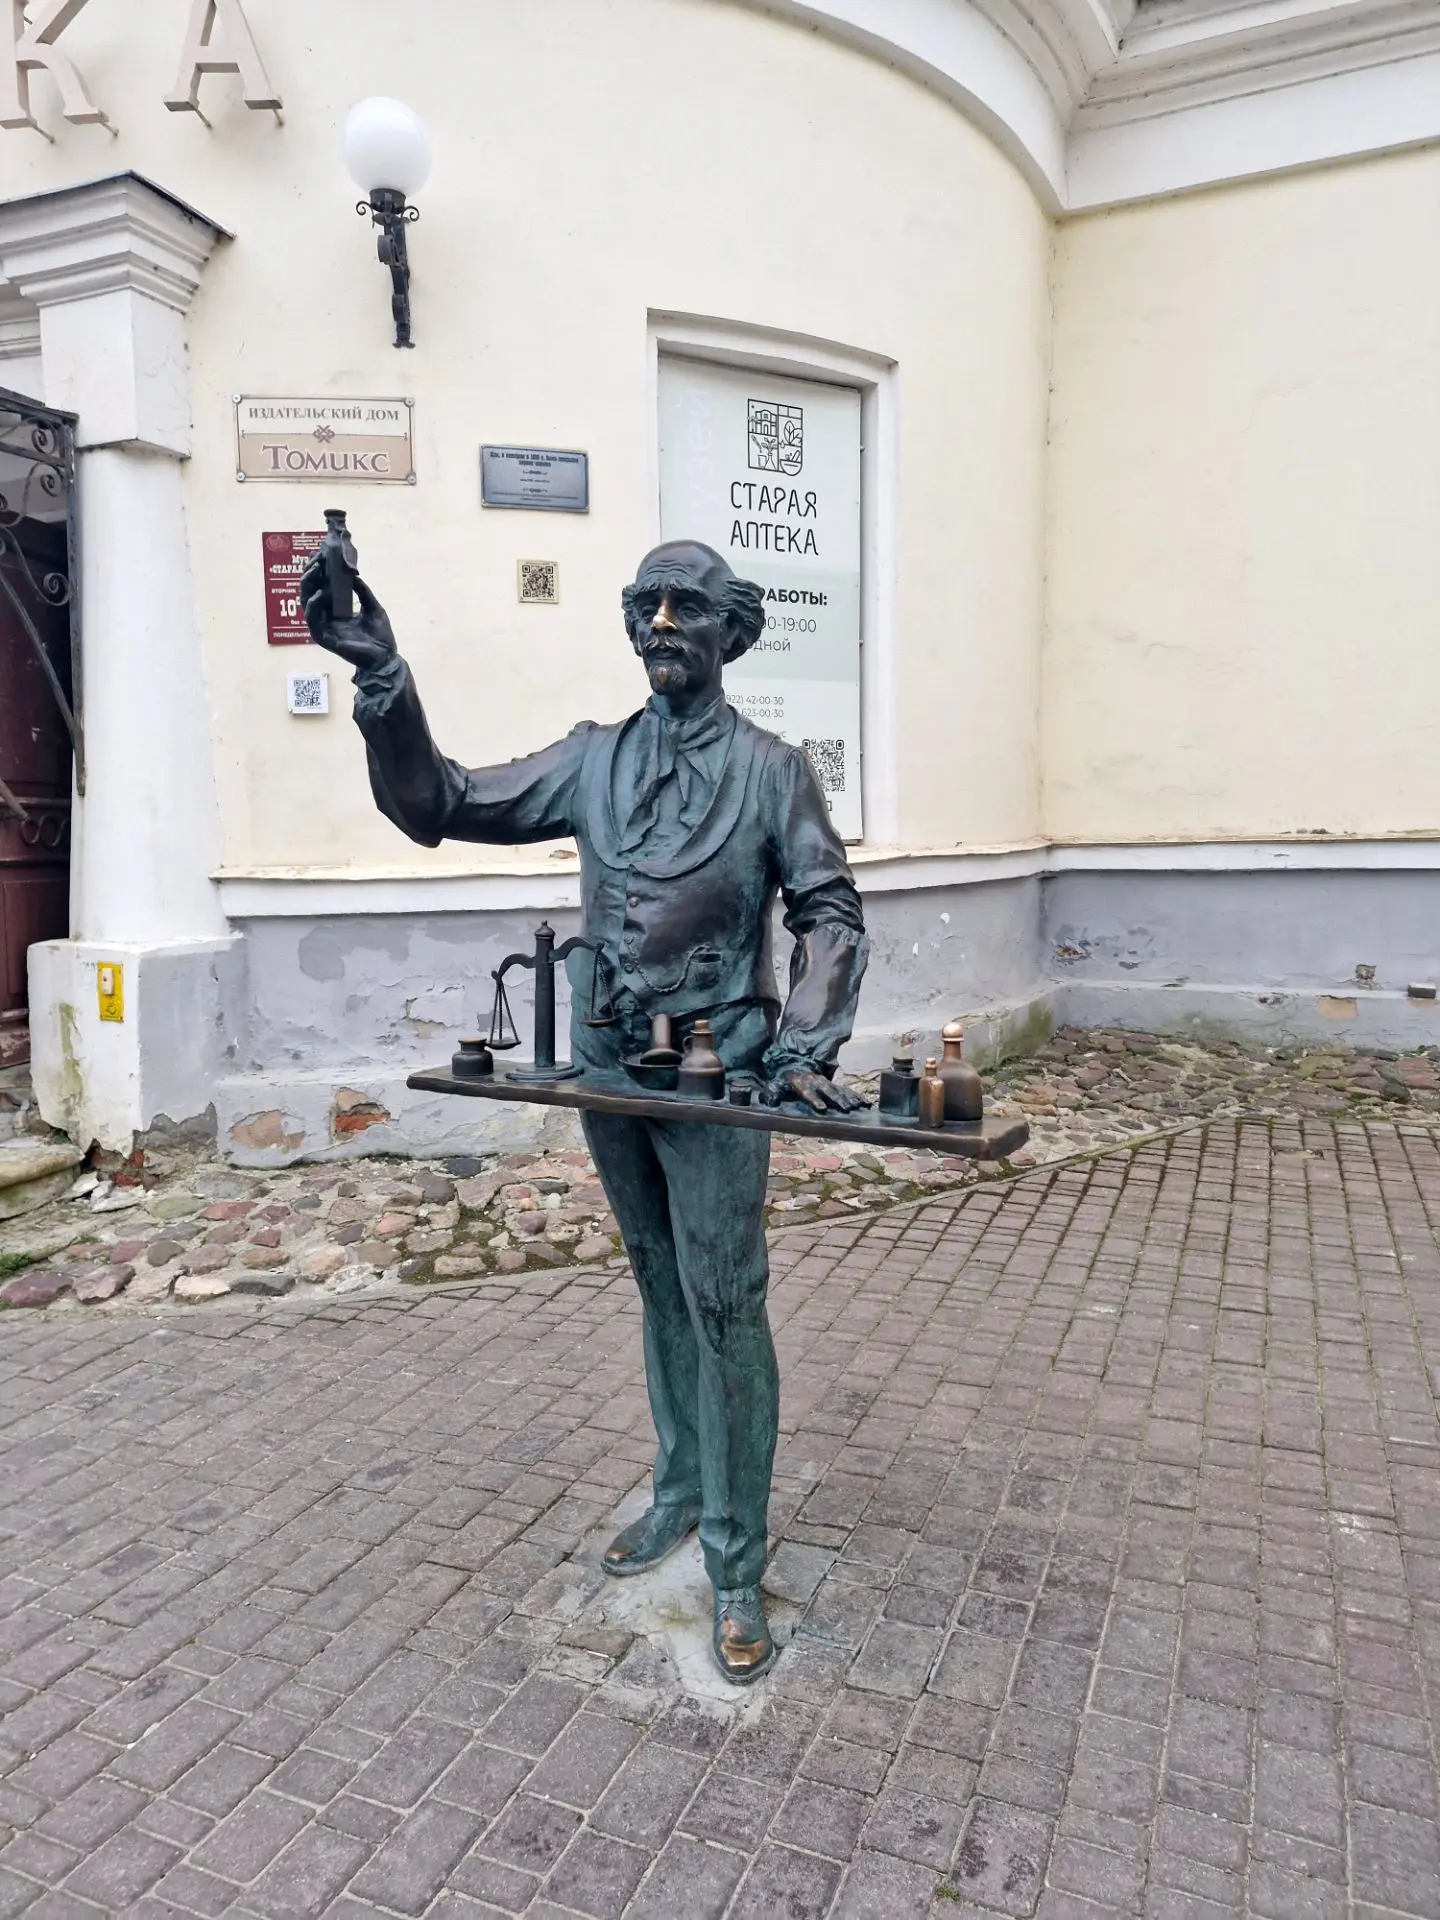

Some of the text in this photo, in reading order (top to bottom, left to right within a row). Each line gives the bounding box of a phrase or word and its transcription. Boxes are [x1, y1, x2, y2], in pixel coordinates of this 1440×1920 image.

[249, 405, 399, 421] ИЗДАТЕЛЬСКИЙ ДОМ
[731, 481, 817, 519] СТАРАЯ
[730, 520, 819, 556] АПТЕКА
[761, 588, 827, 605] АБОТЫ:
[762, 616, 817, 633] 0-19:00
[726, 694, 784, 706] 922) 42-00-30
